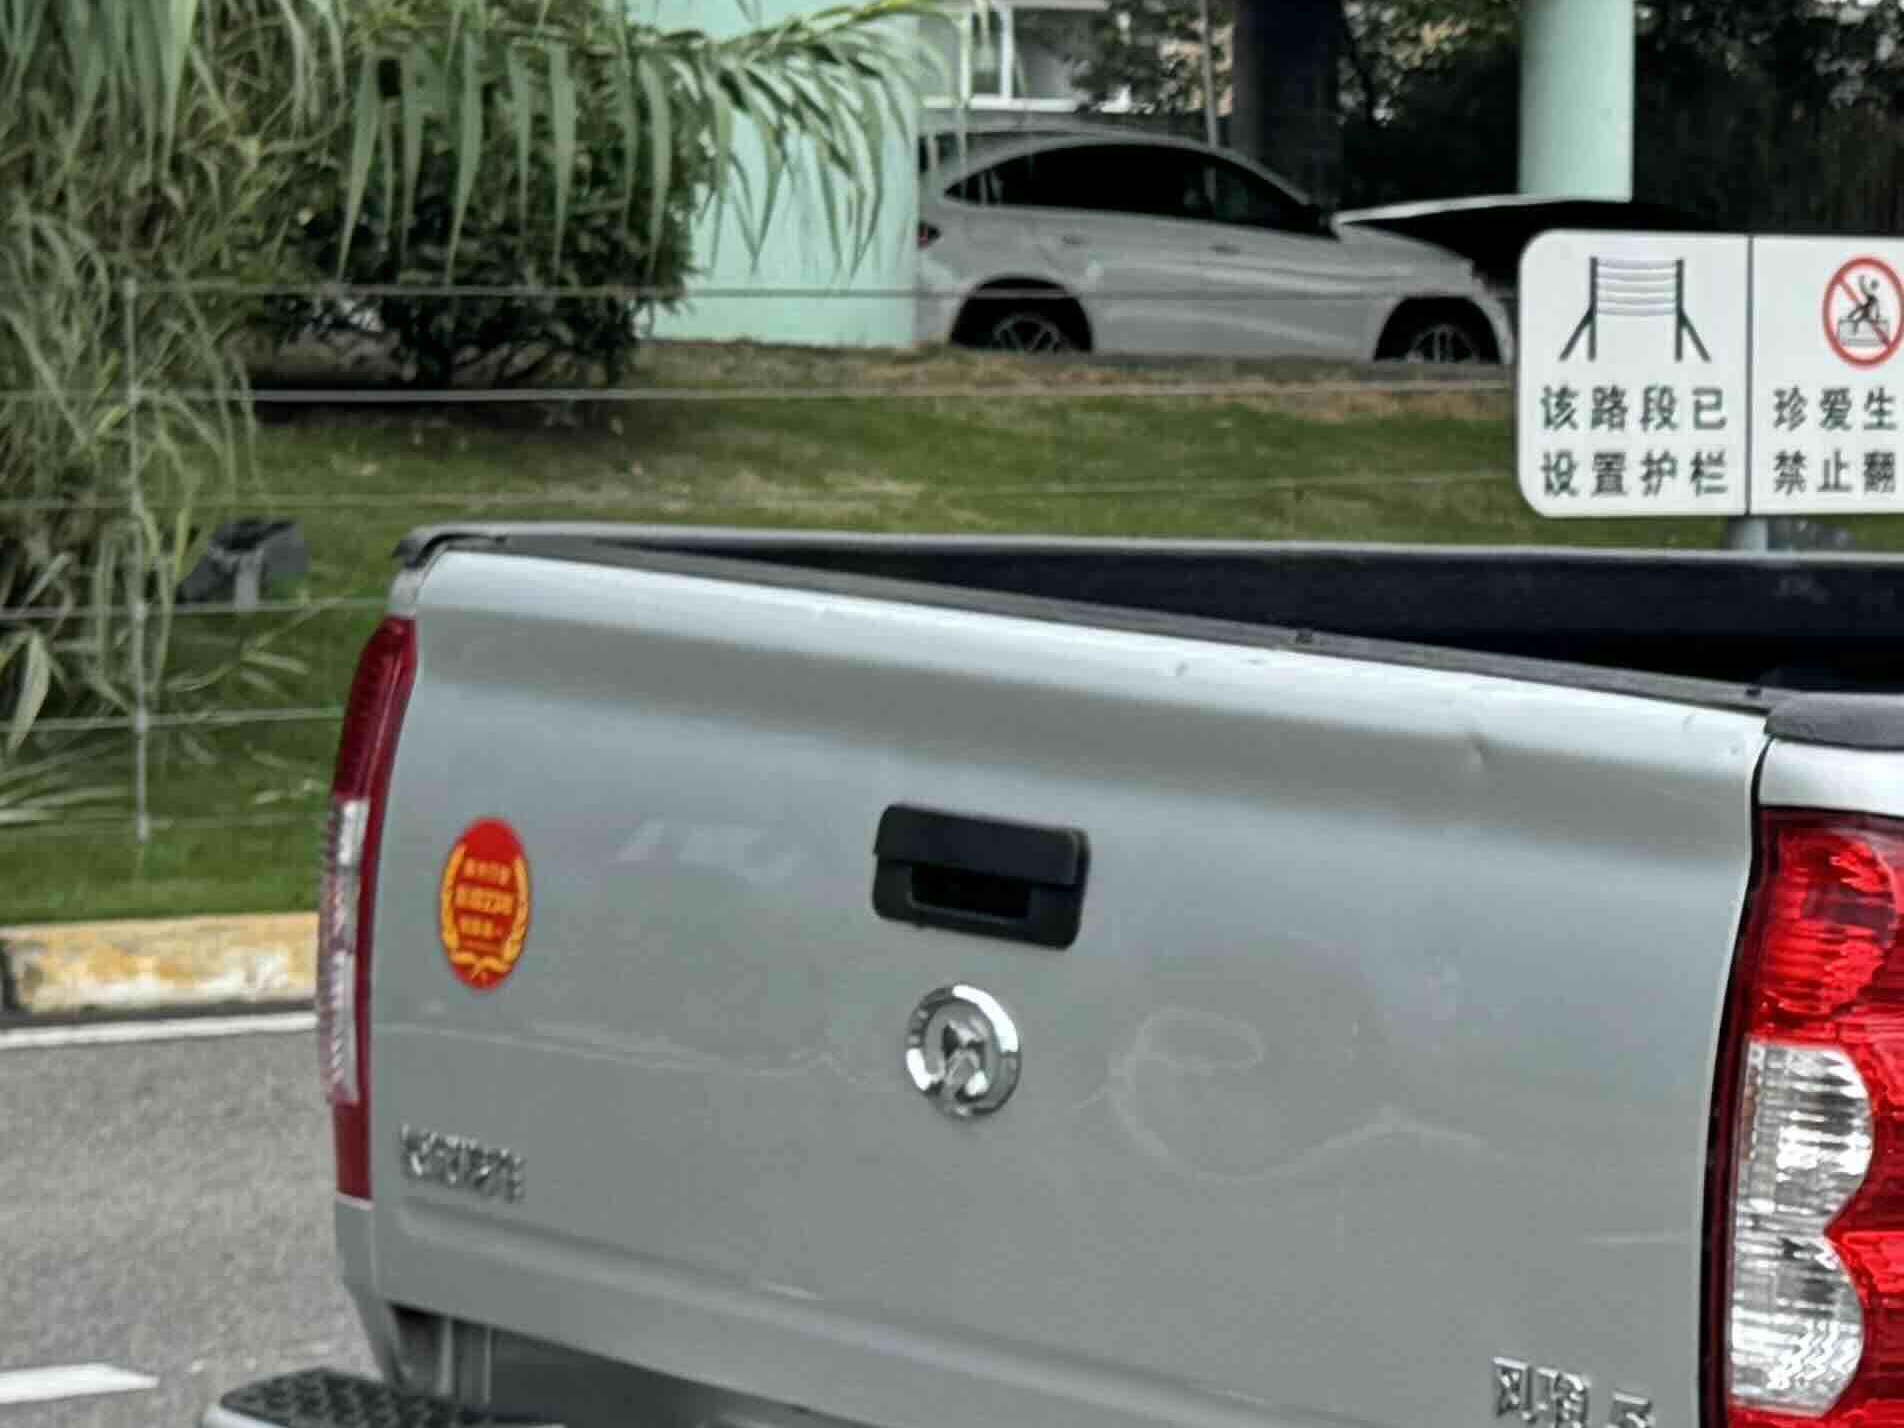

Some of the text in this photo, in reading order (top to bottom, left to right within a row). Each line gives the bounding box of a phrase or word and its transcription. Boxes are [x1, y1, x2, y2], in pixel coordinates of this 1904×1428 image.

[1540, 385, 1728, 432] 该路段已
[1541, 450, 1729, 497] 设置护栏
